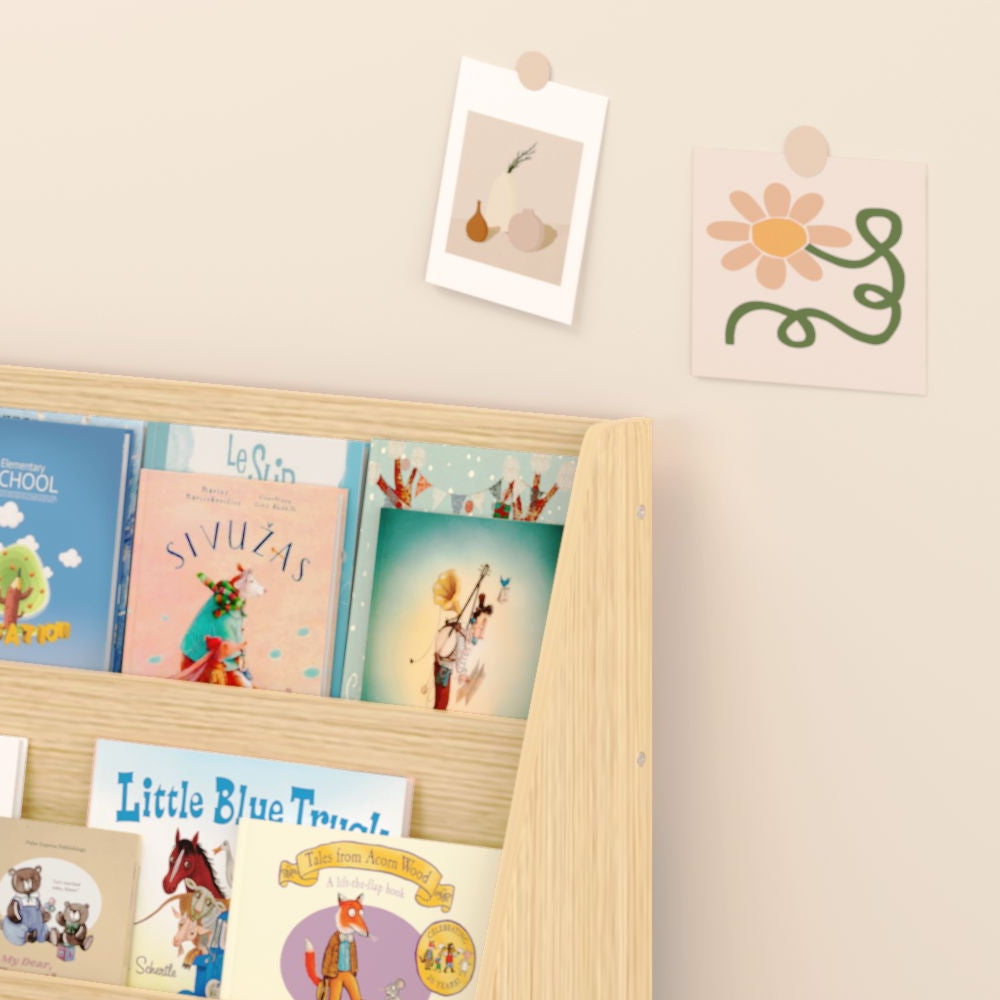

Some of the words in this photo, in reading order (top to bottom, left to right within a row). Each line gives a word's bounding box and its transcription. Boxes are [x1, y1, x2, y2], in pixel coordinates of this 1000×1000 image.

[1, 457, 46, 474] Elementary
[227, 433, 247, 474] Le
[166, 519, 310, 582] SIVUŽAS
[116, 771, 204, 823] Little
[213, 776, 284, 826] Blue
[304, 851, 333, 867] Tales
[336, 848, 361, 864] from
[365, 848, 399, 870] Acorn
[401, 855, 432, 884] Wood
[2, 954, 20, 967] My
